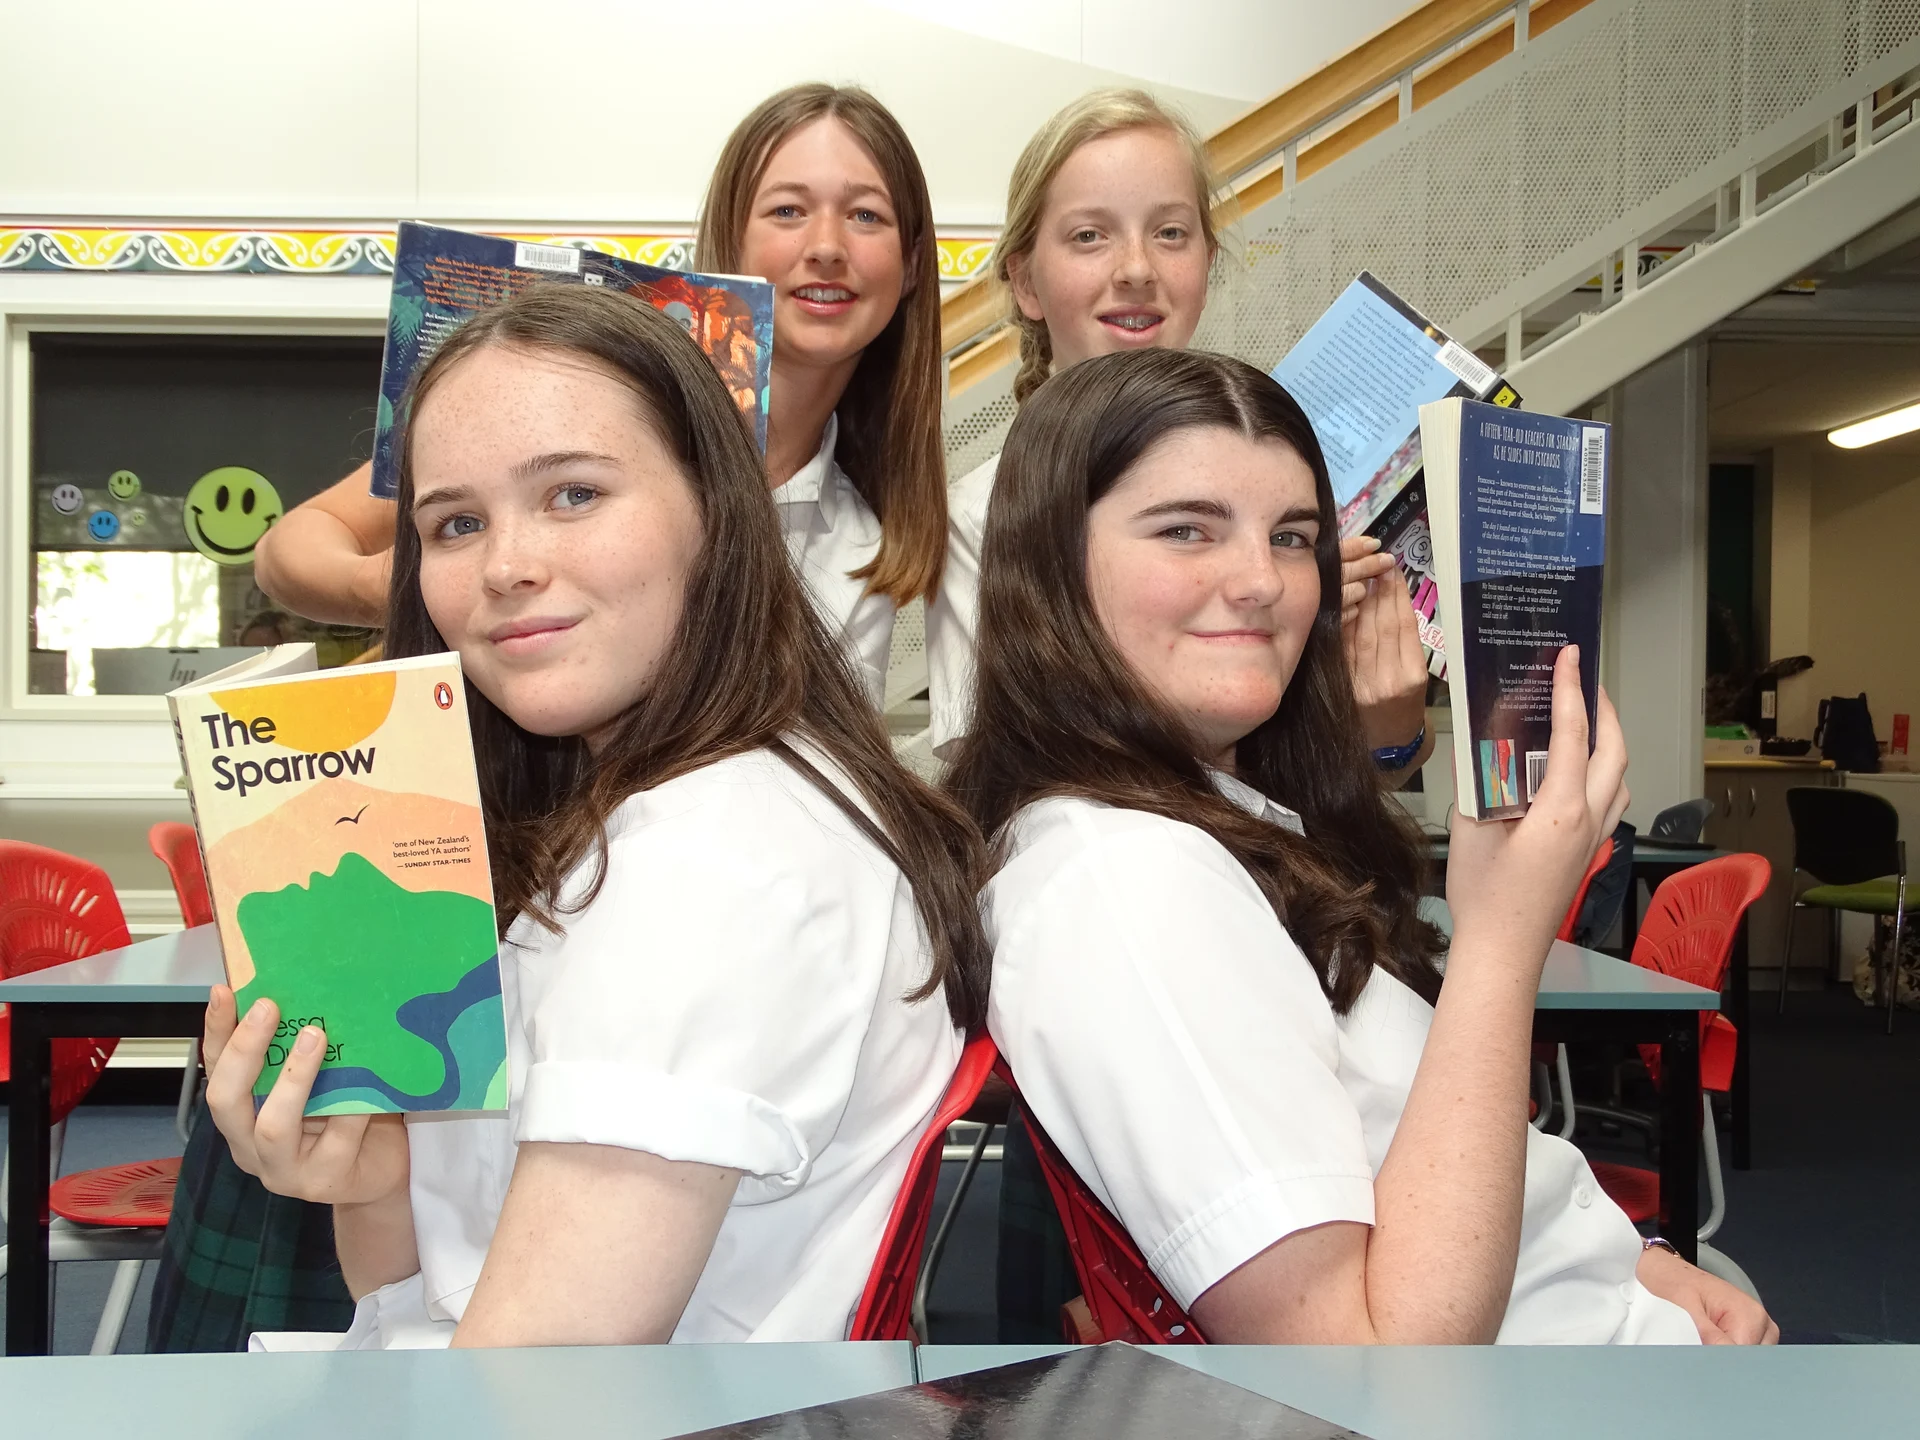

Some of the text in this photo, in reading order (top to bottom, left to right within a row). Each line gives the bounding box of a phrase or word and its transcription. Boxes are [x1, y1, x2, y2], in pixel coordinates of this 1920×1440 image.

[1500, 396, 1507, 404] 2
[1525, 430, 1544, 446] REACHES
[1546, 432, 1554, 448] FOR
[1494, 444, 1500, 460] AS
[170, 658, 197, 687] hp
[200, 712, 276, 749] The
[212, 748, 376, 797] Sparrow
[437, 836, 470, 844] Zealand's
[393, 848, 430, 858] best-loved
[432, 858, 471, 866] STAR-TIMES
[274, 1016, 326, 1038] essa
